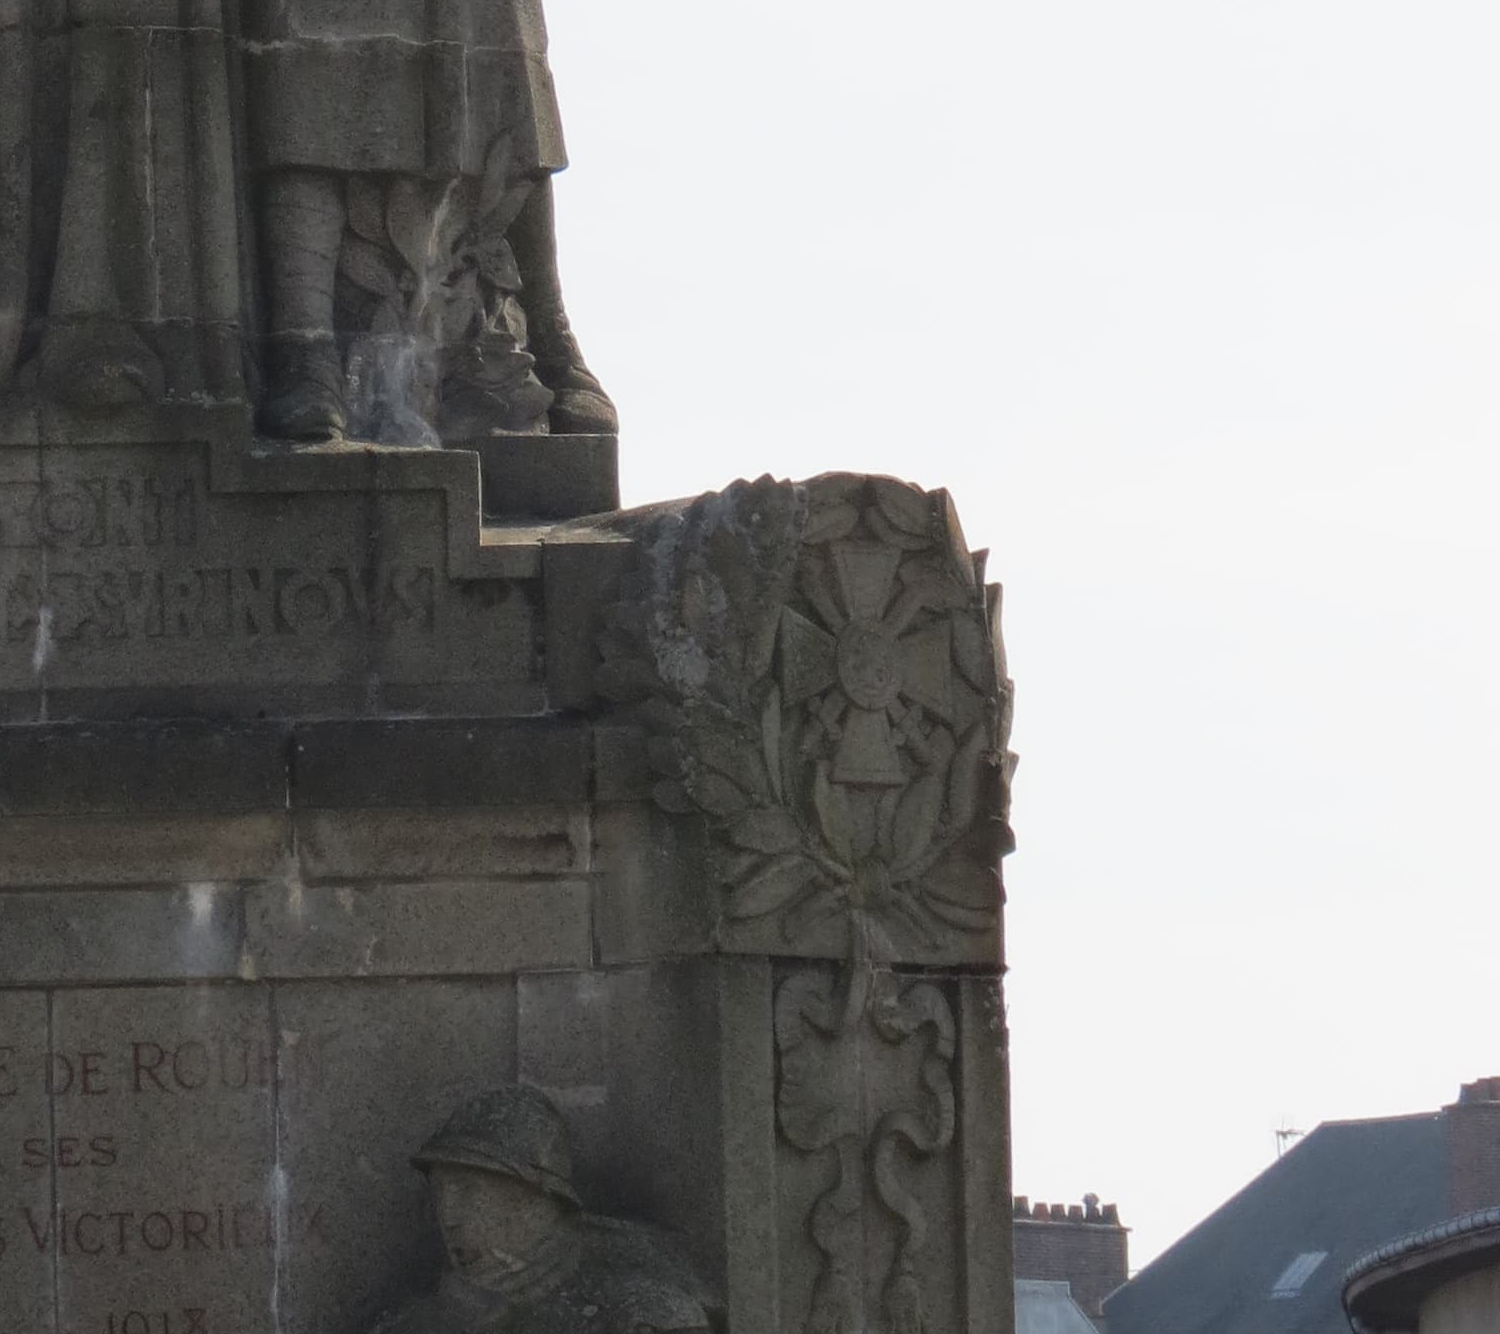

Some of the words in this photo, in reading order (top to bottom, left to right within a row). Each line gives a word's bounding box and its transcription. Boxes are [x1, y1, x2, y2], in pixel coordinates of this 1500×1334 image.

[45, 1051, 109, 1097] DE
[21, 1134, 119, 1169] SES
[21, 1203, 326, 1258] VICTORIEX
